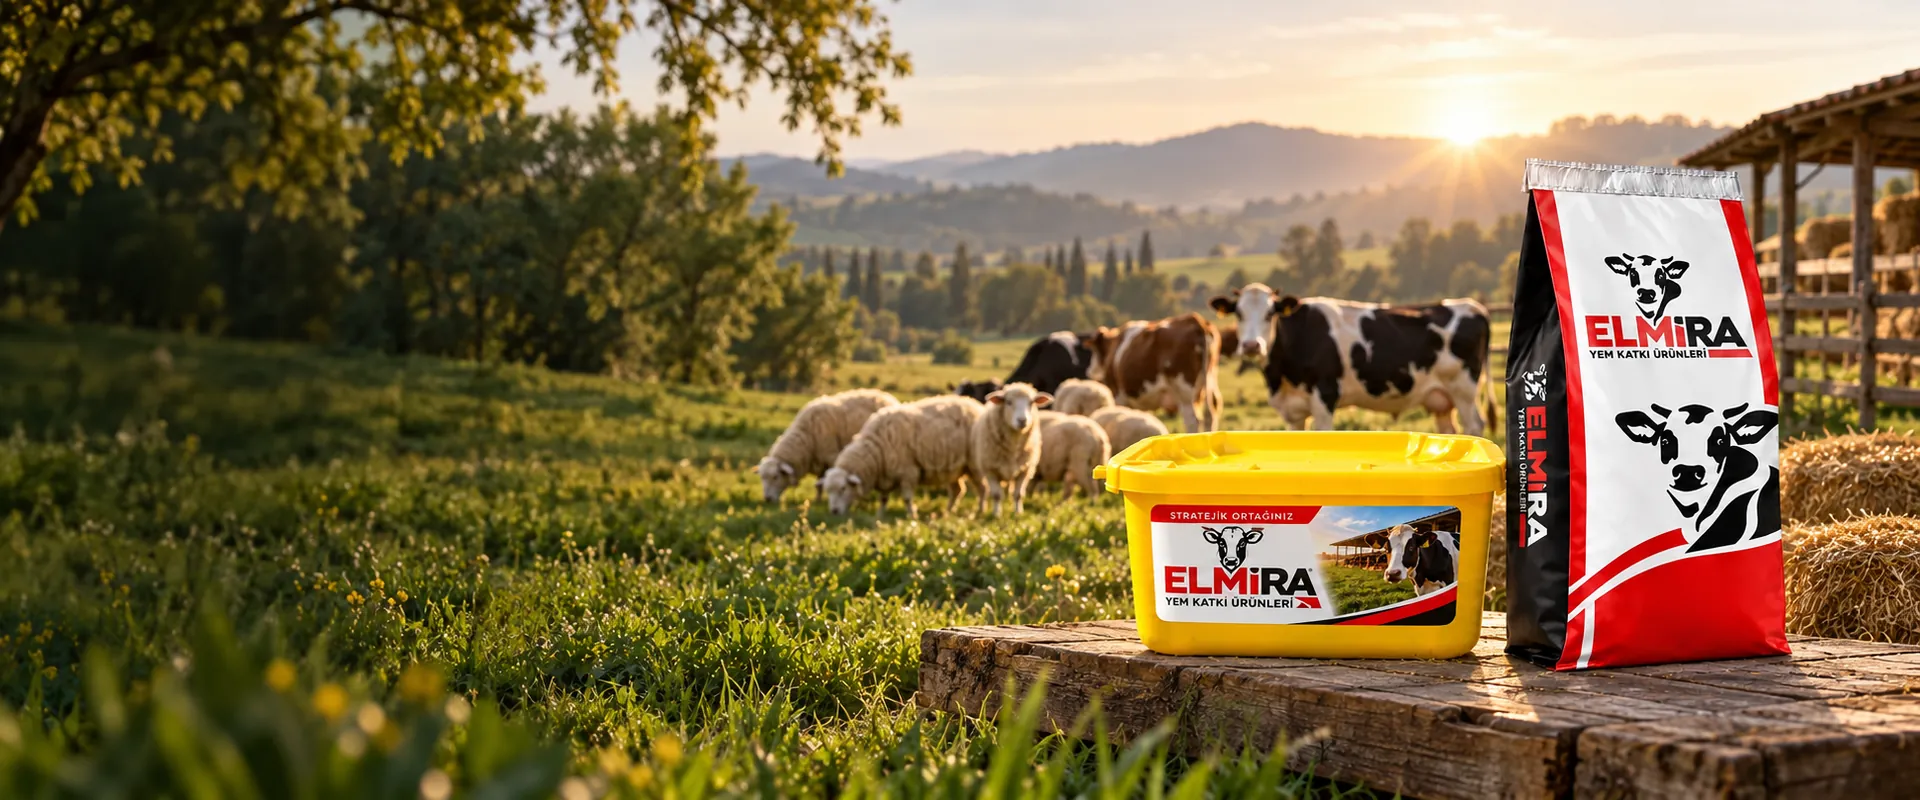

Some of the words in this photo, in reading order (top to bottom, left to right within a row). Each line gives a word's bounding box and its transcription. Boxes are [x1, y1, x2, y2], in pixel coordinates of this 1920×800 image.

[1590, 350, 1614, 359] YEM
[1617, 350, 1650, 359] KATKI
[1170, 511, 1228, 520] STRATEJİK
[1232, 511, 1293, 521] ORTAĞINIZ
[1165, 597, 1189, 607] YEM
[1231, 597, 1293, 609] ÜRÜNLERİ
